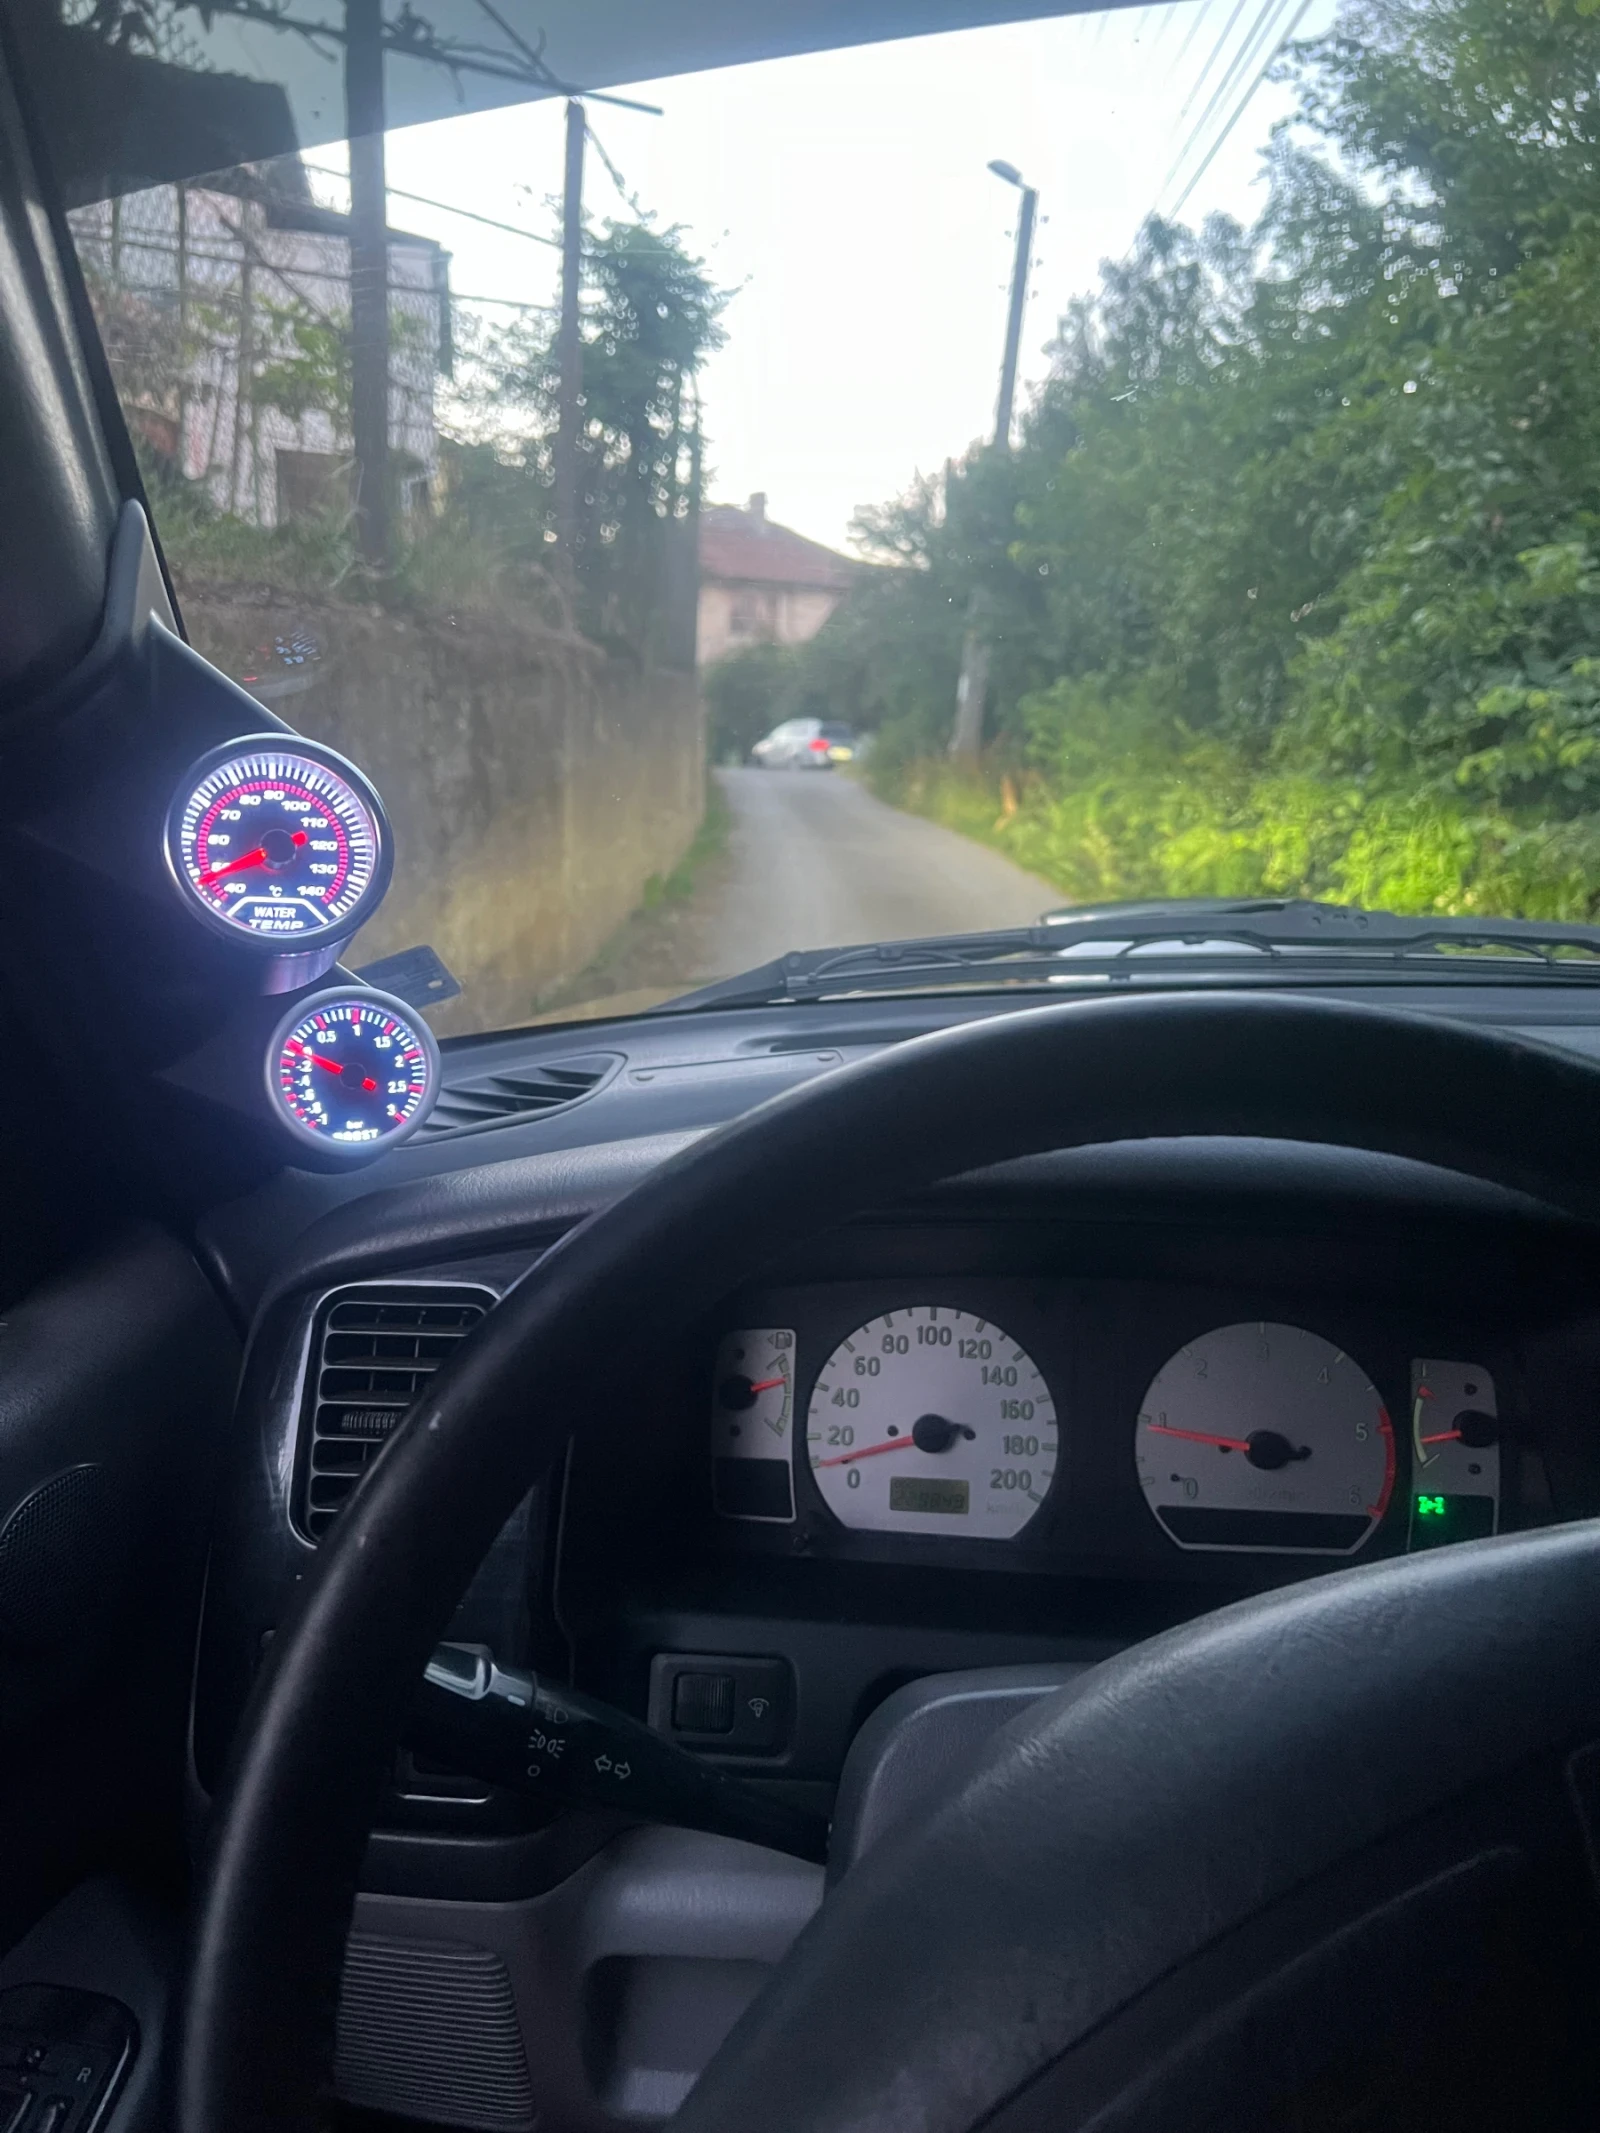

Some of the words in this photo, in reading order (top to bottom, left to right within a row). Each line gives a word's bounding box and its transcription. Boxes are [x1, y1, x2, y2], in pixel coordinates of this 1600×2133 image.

[239, 795, 261, 806] 80
[263, 790, 285, 801] 90
[281, 800, 311, 811] 100
[220, 810, 241, 821] 70
[300, 817, 328, 828] 110
[208, 835, 230, 845] 60
[309, 840, 338, 851] 120
[309, 864, 338, 874] 130
[224, 883, 246, 894] 40
[297, 886, 326, 897] 140
[254, 906, 297, 919] WATER
[249, 919, 304, 931] TEMP
[352, 1024, 362, 1036] 1
[316, 1031, 337, 1044] 0.5
[373, 1036, 391, 1048] 1.5
[394, 1055, 405, 1068] 2
[387, 1081, 407, 1093] 2.5
[386, 1104, 397, 1116] 3
[916, 1325, 952, 1346] 100
[881, 1334, 909, 1355] 80
[958, 1338, 993, 1360] 120
[1258, 1342, 1270, 1361] 3
[854, 1356, 881, 1376] 60
[1194, 1358, 1209, 1379] 2
[981, 1365, 1018, 1387] 140
[1316, 1366, 1330, 1385] 4
[831, 1388, 860, 1408] 40
[1000, 1399, 1035, 1421] 160
[827, 1425, 854, 1446] 20
[1355, 1422, 1368, 1441] 5
[1003, 1435, 1039, 1456] 180
[847, 1469, 861, 1489] 0
[990, 1469, 1032, 1491] 200
[1184, 1478, 1199, 1499] 0
[76, 2067, 92, 2083] R
